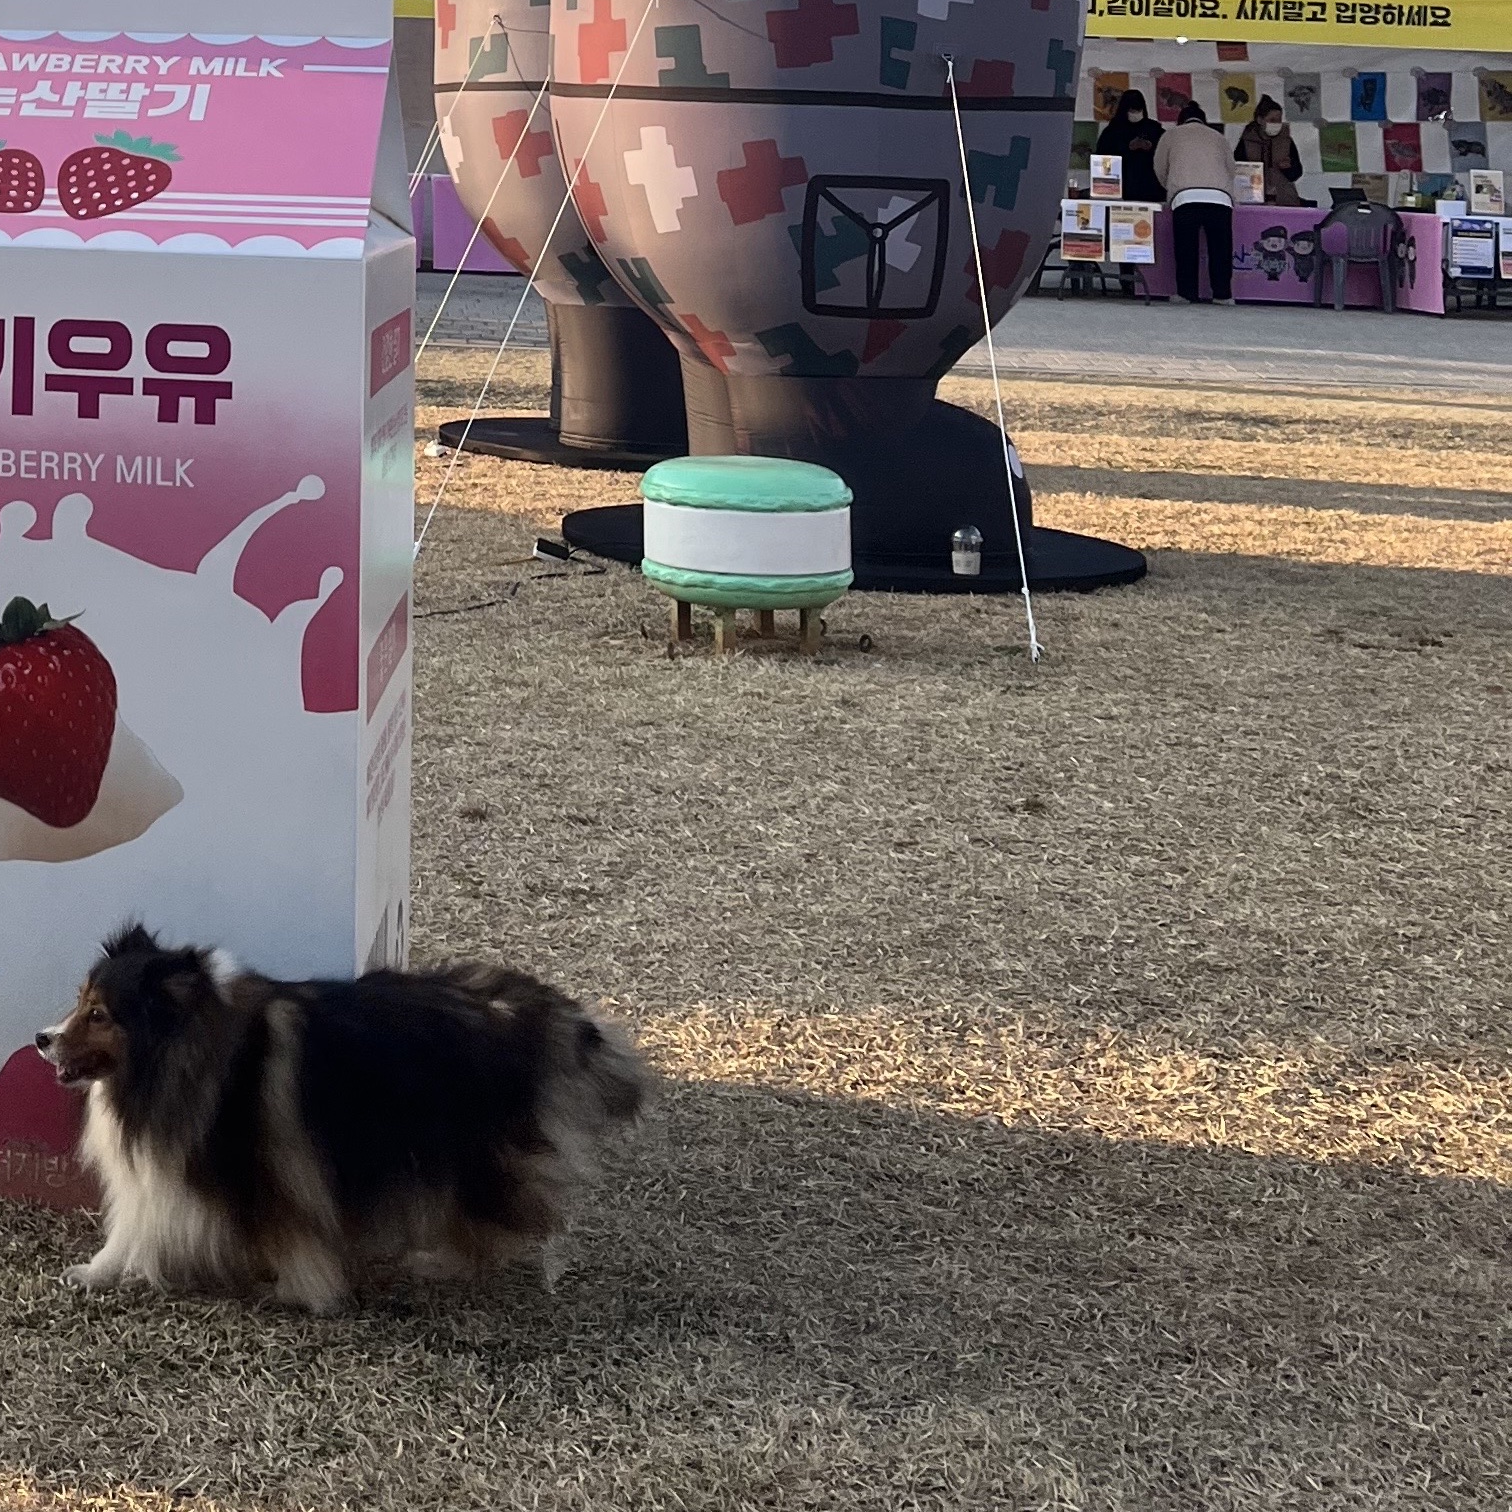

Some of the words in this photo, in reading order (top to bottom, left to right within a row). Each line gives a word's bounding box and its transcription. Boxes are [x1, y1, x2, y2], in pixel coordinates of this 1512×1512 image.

[1236, 0, 1328, 23] 사지말고
[1335, 1, 1452, 27] 입양하세요
[188, 55, 288, 78] MILK
[114, 454, 196, 489] MILK
